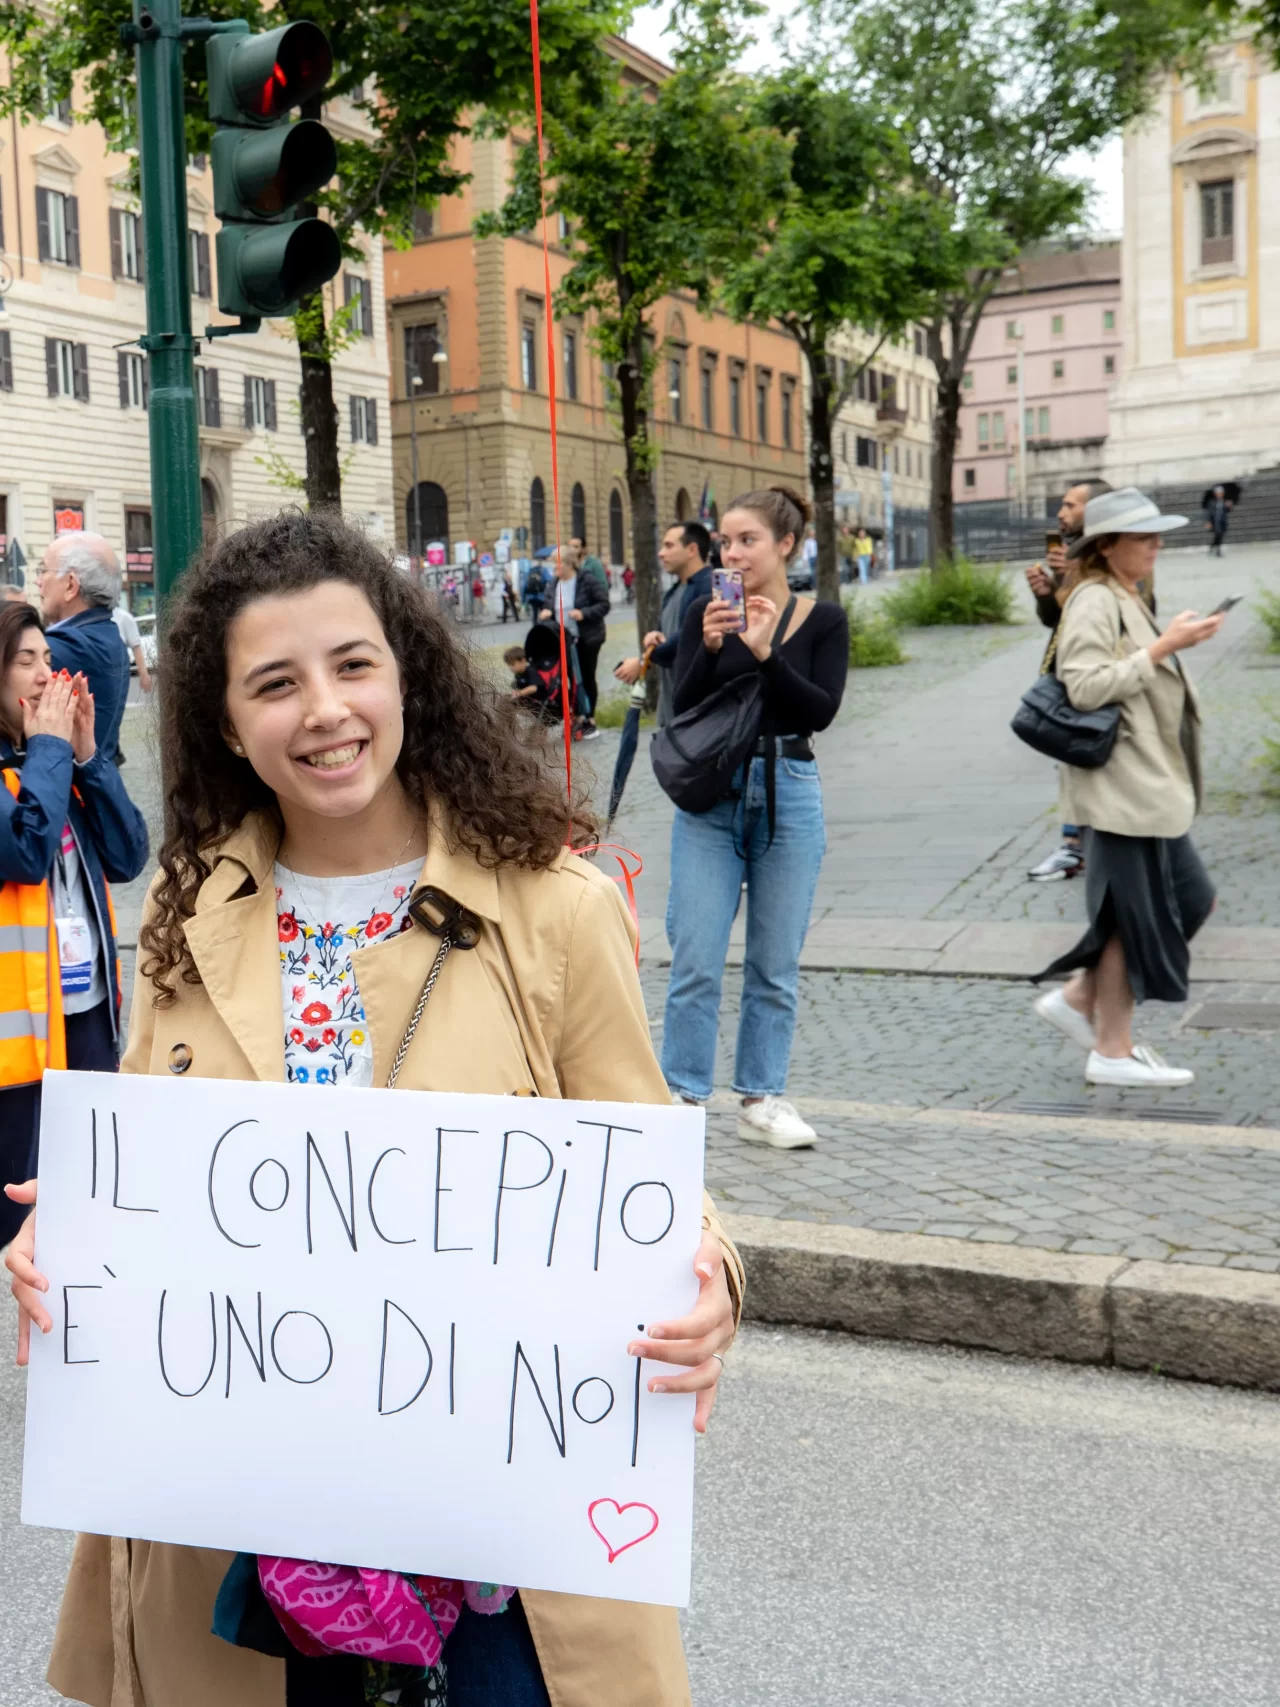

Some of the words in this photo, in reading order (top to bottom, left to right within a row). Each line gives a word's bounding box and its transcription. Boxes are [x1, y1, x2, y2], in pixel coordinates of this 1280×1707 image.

[91, 1108, 159, 1213] IL
[207, 1118, 676, 1272] CONCEPITO
[62, 1264, 117, 1365] È
[158, 1289, 334, 1398] UNO
[377, 1298, 456, 1415] DI
